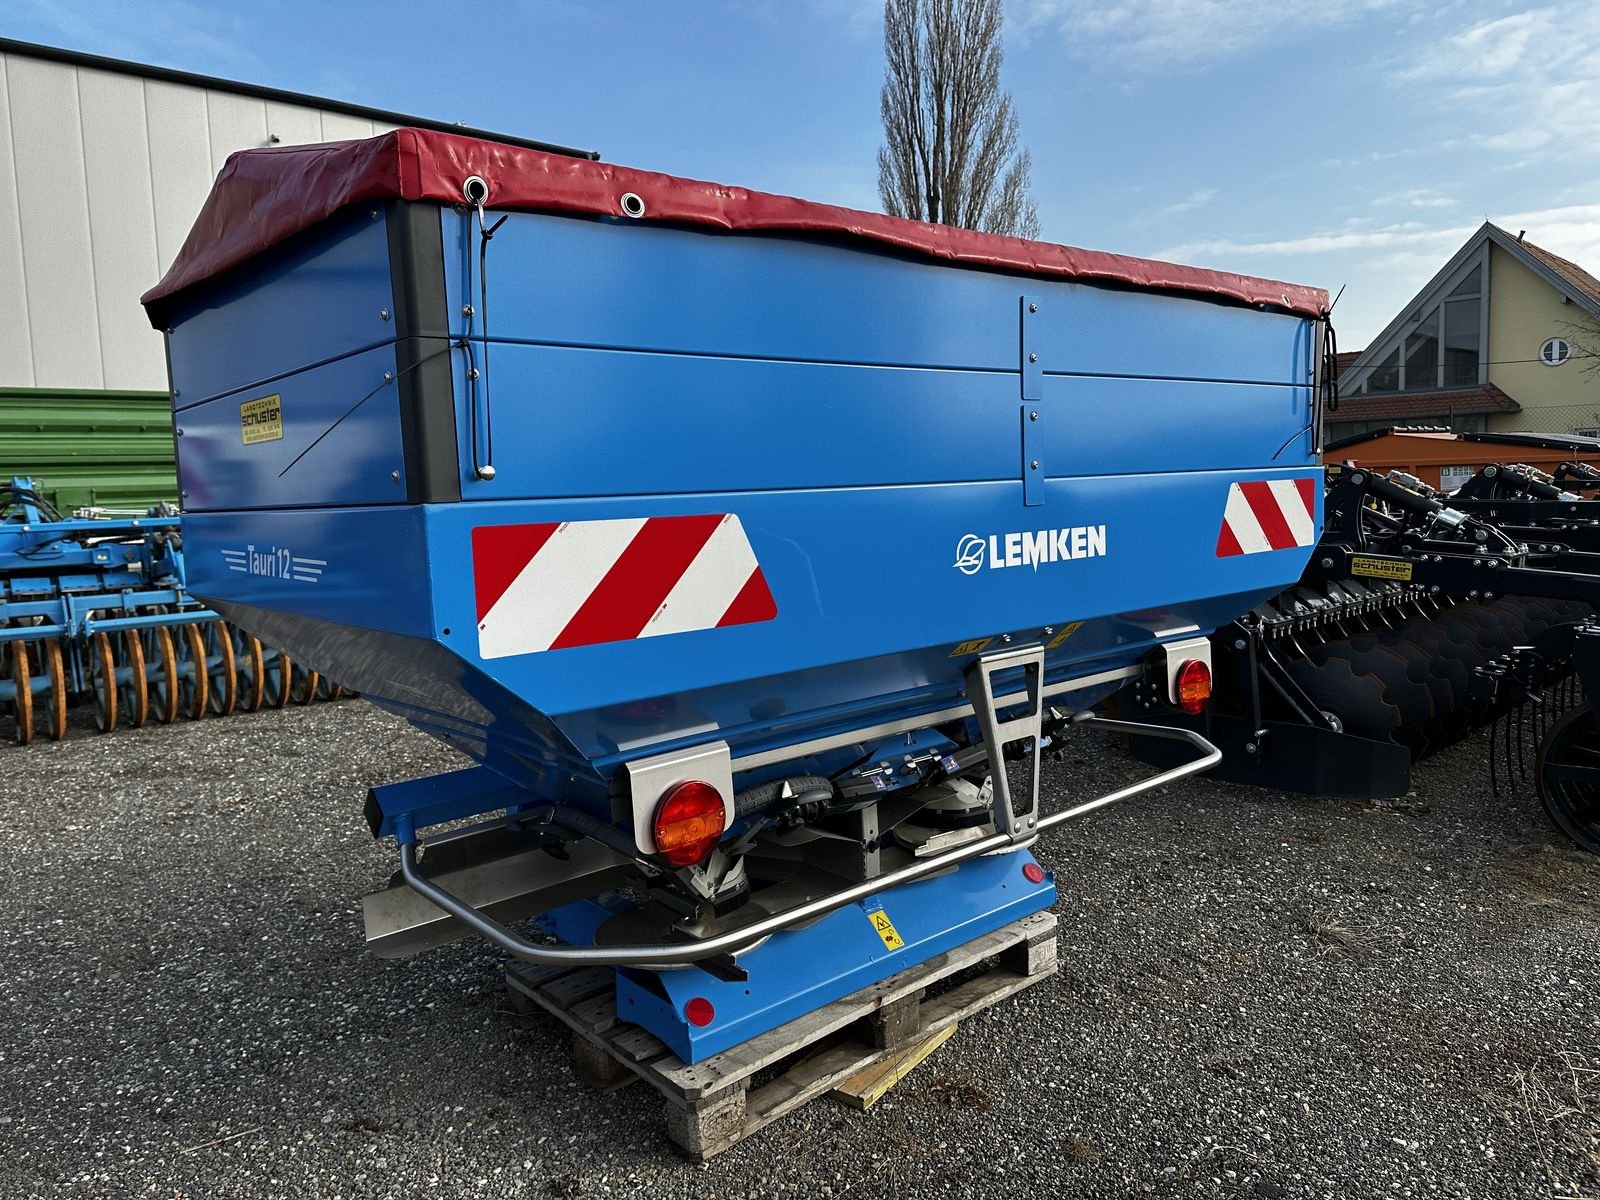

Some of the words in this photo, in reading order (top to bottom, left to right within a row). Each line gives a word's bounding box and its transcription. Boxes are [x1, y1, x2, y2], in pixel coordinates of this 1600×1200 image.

[241, 407, 280, 427] schuster
[247, 545, 275, 577] Tauri
[277, 548, 290, 579] 12
[989, 525, 1106, 574] LEMKEN
